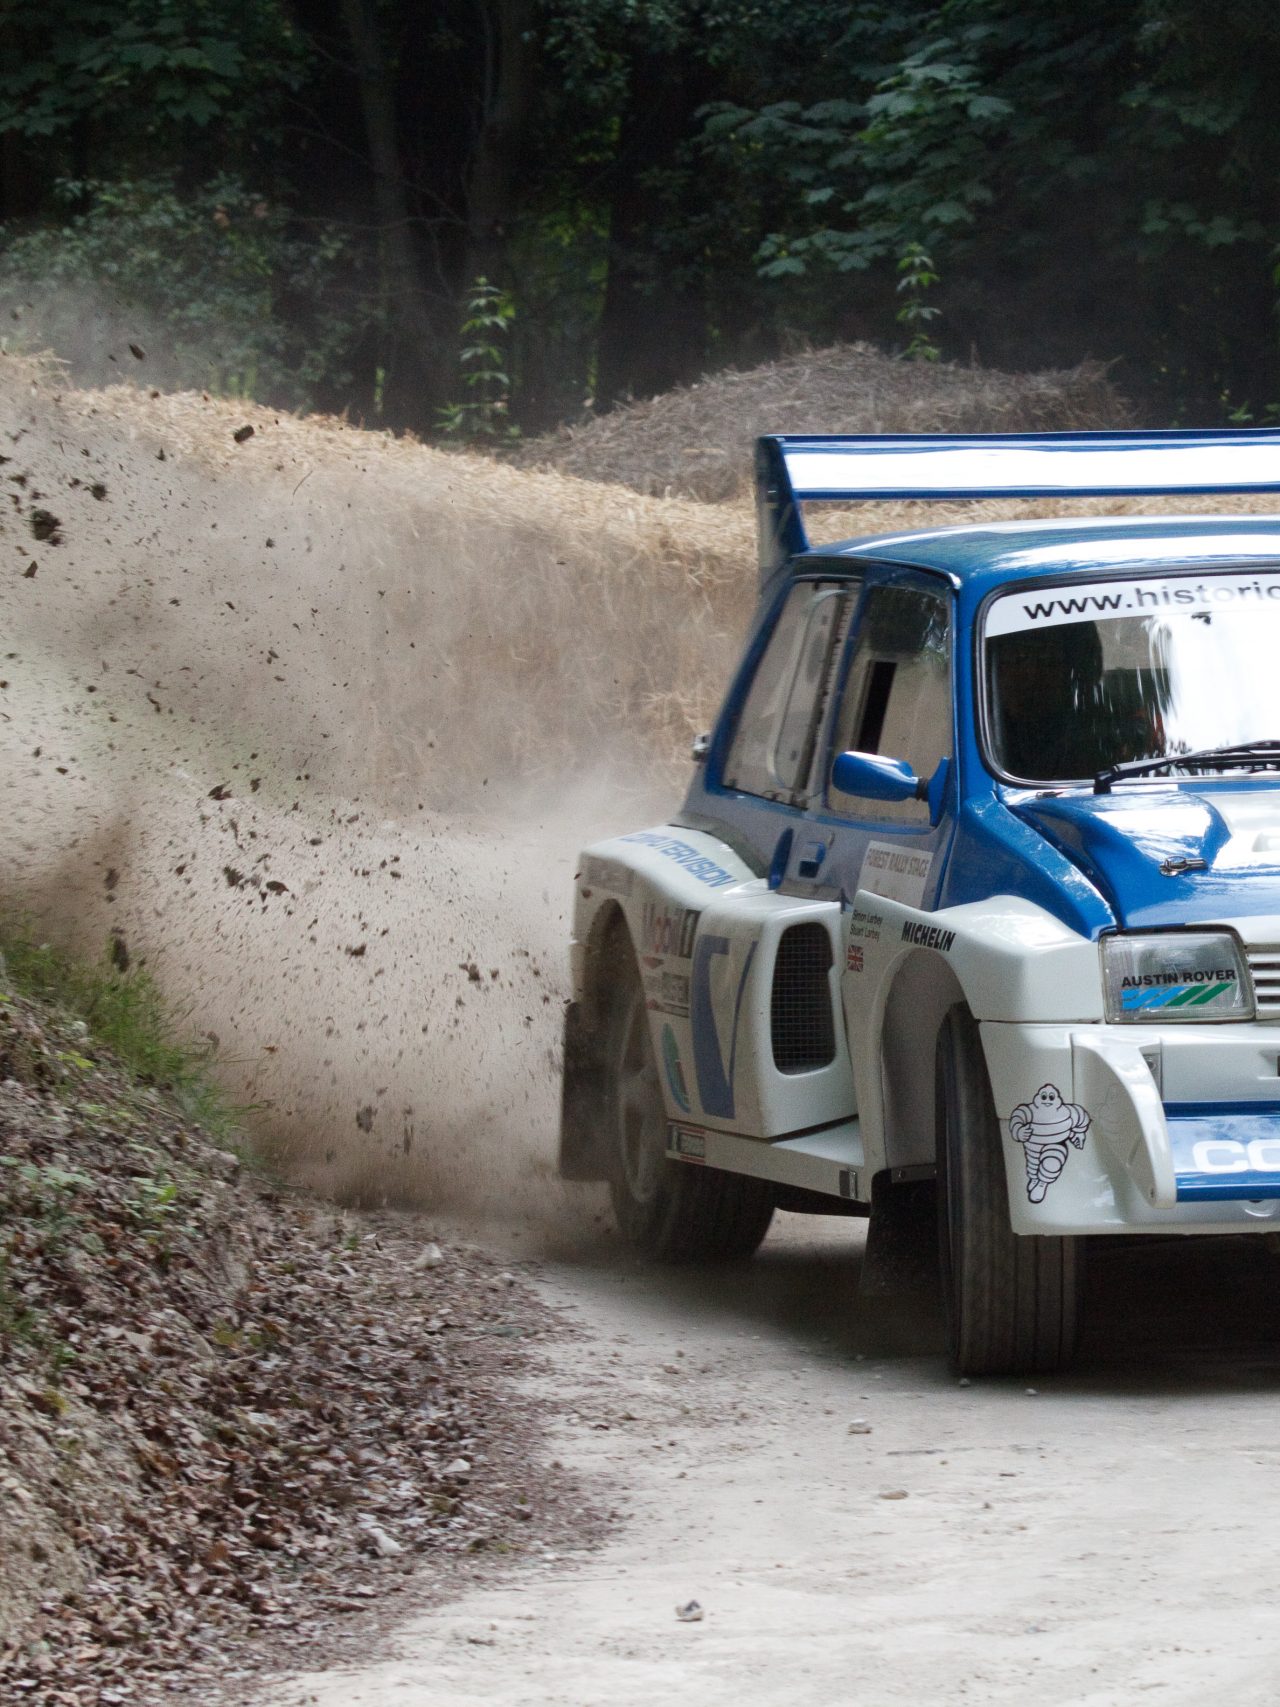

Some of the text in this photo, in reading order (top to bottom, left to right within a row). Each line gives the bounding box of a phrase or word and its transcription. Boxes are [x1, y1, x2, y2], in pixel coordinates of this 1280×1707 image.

[901, 921, 956, 951] MICHELIN
[1121, 969, 1236, 987] AUSTIN ROVER
